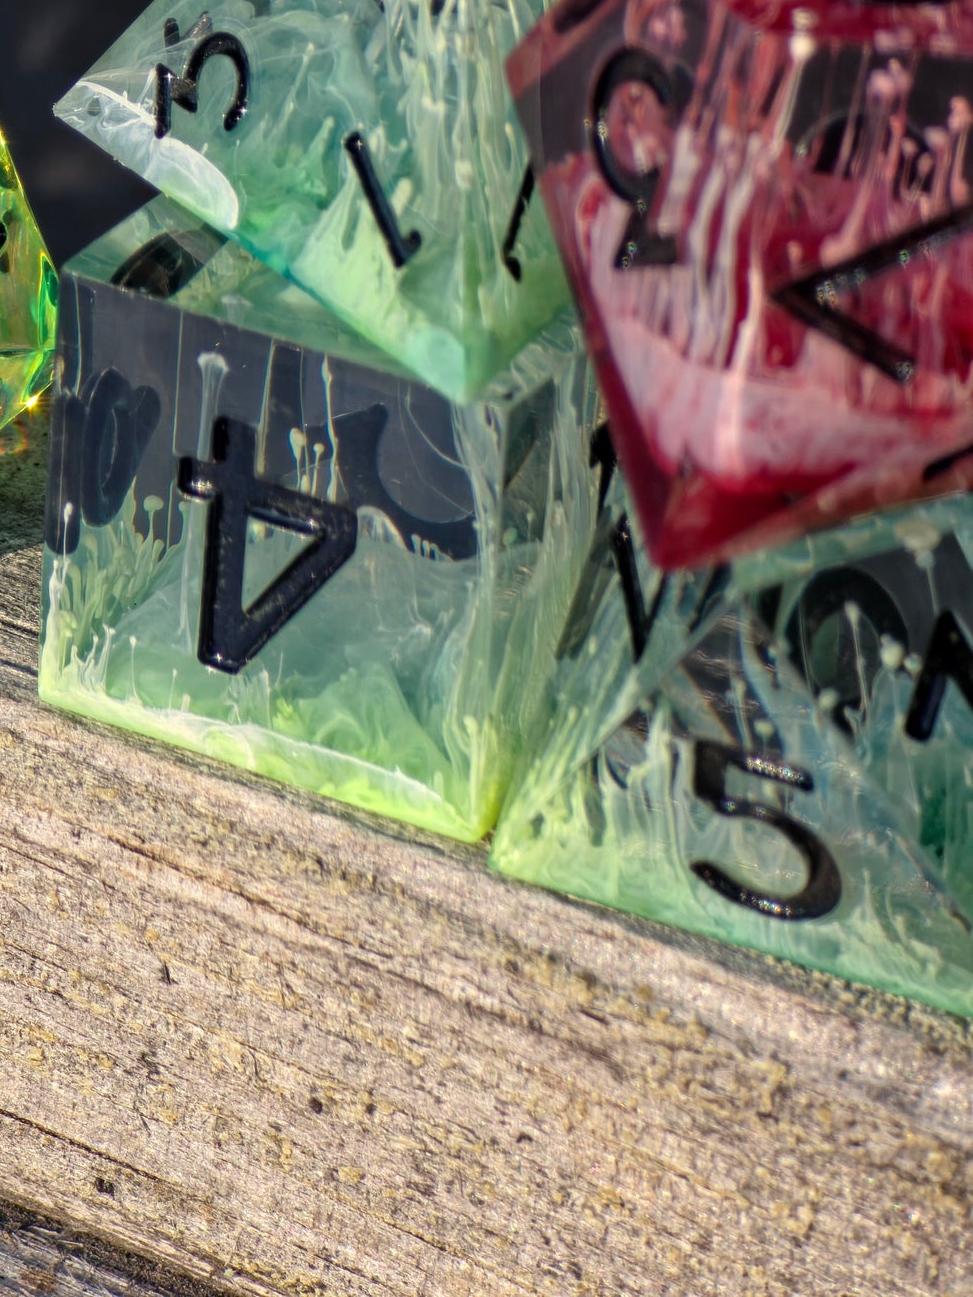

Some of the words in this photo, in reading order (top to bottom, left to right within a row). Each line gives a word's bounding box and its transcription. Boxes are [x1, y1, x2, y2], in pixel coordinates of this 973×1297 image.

[154, 31, 249, 139] 3
[343, 131, 421, 268] 1
[177, 416, 358, 673] 4
[690, 739, 843, 922] 5
